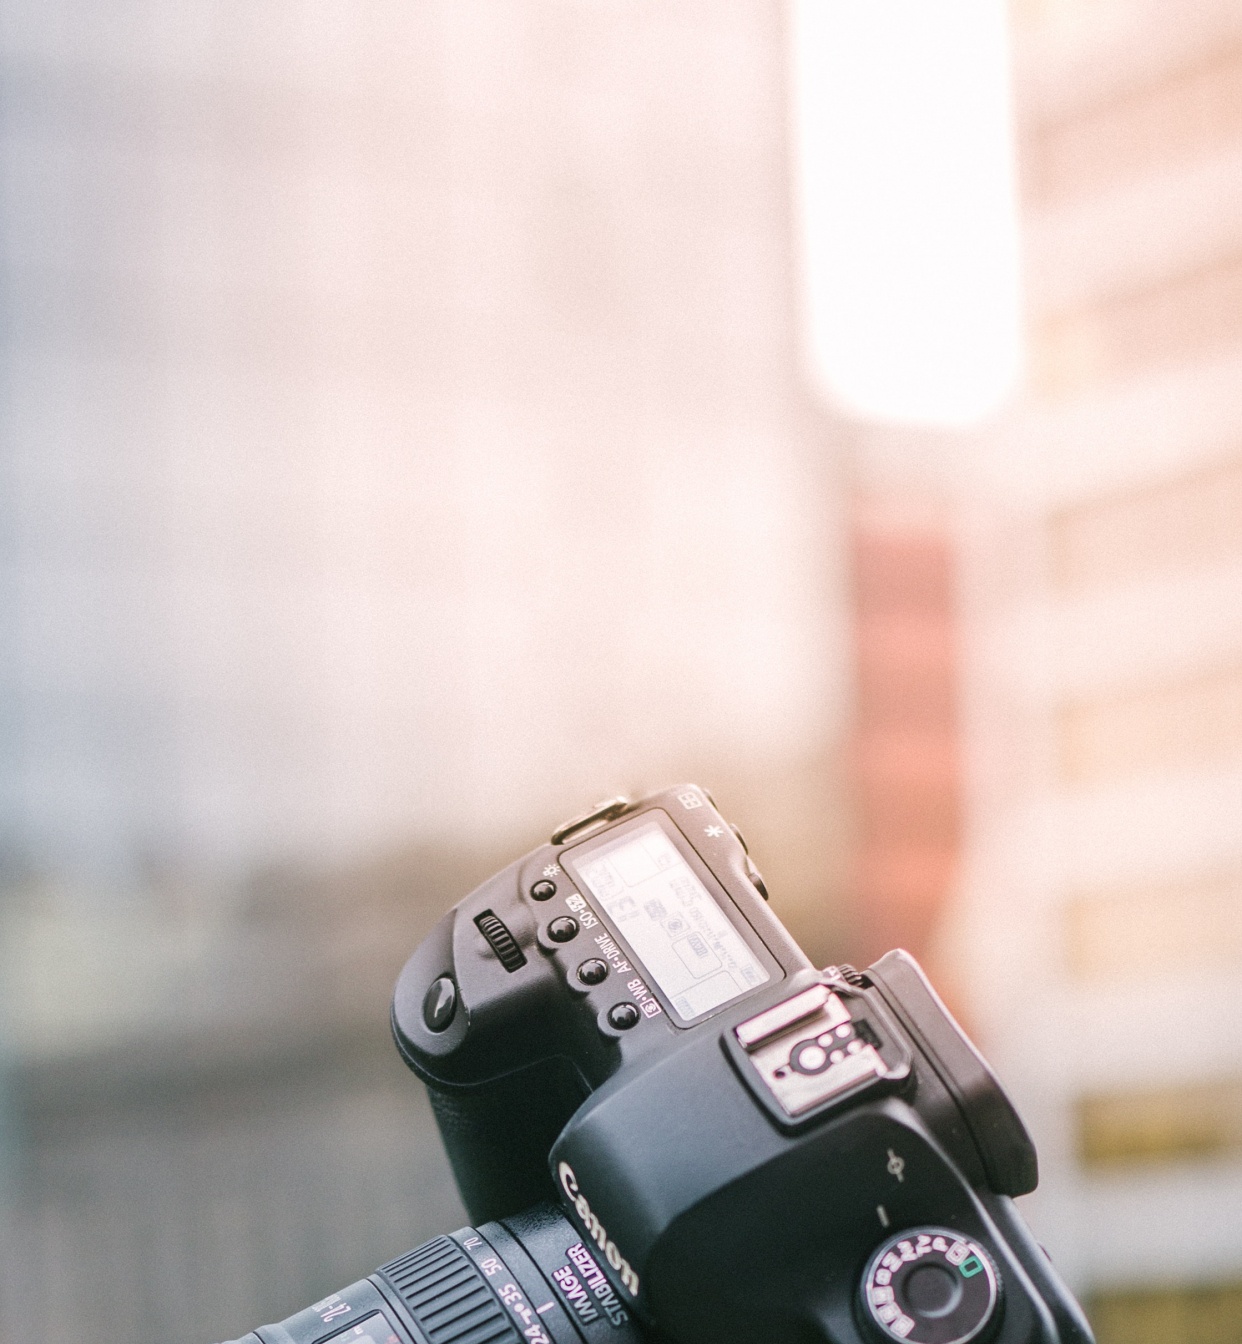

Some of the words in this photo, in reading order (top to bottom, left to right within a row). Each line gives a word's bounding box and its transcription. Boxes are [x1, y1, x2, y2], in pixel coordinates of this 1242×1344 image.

[463, 1236, 483, 1251] 70
[558, 1160, 640, 1297] Canon
[481, 1258, 503, 1277] 50
[566, 1243, 629, 1327] STABILIZER
[498, 1283, 522, 1306] 35
[552, 1264, 600, 1323] IMAGE
